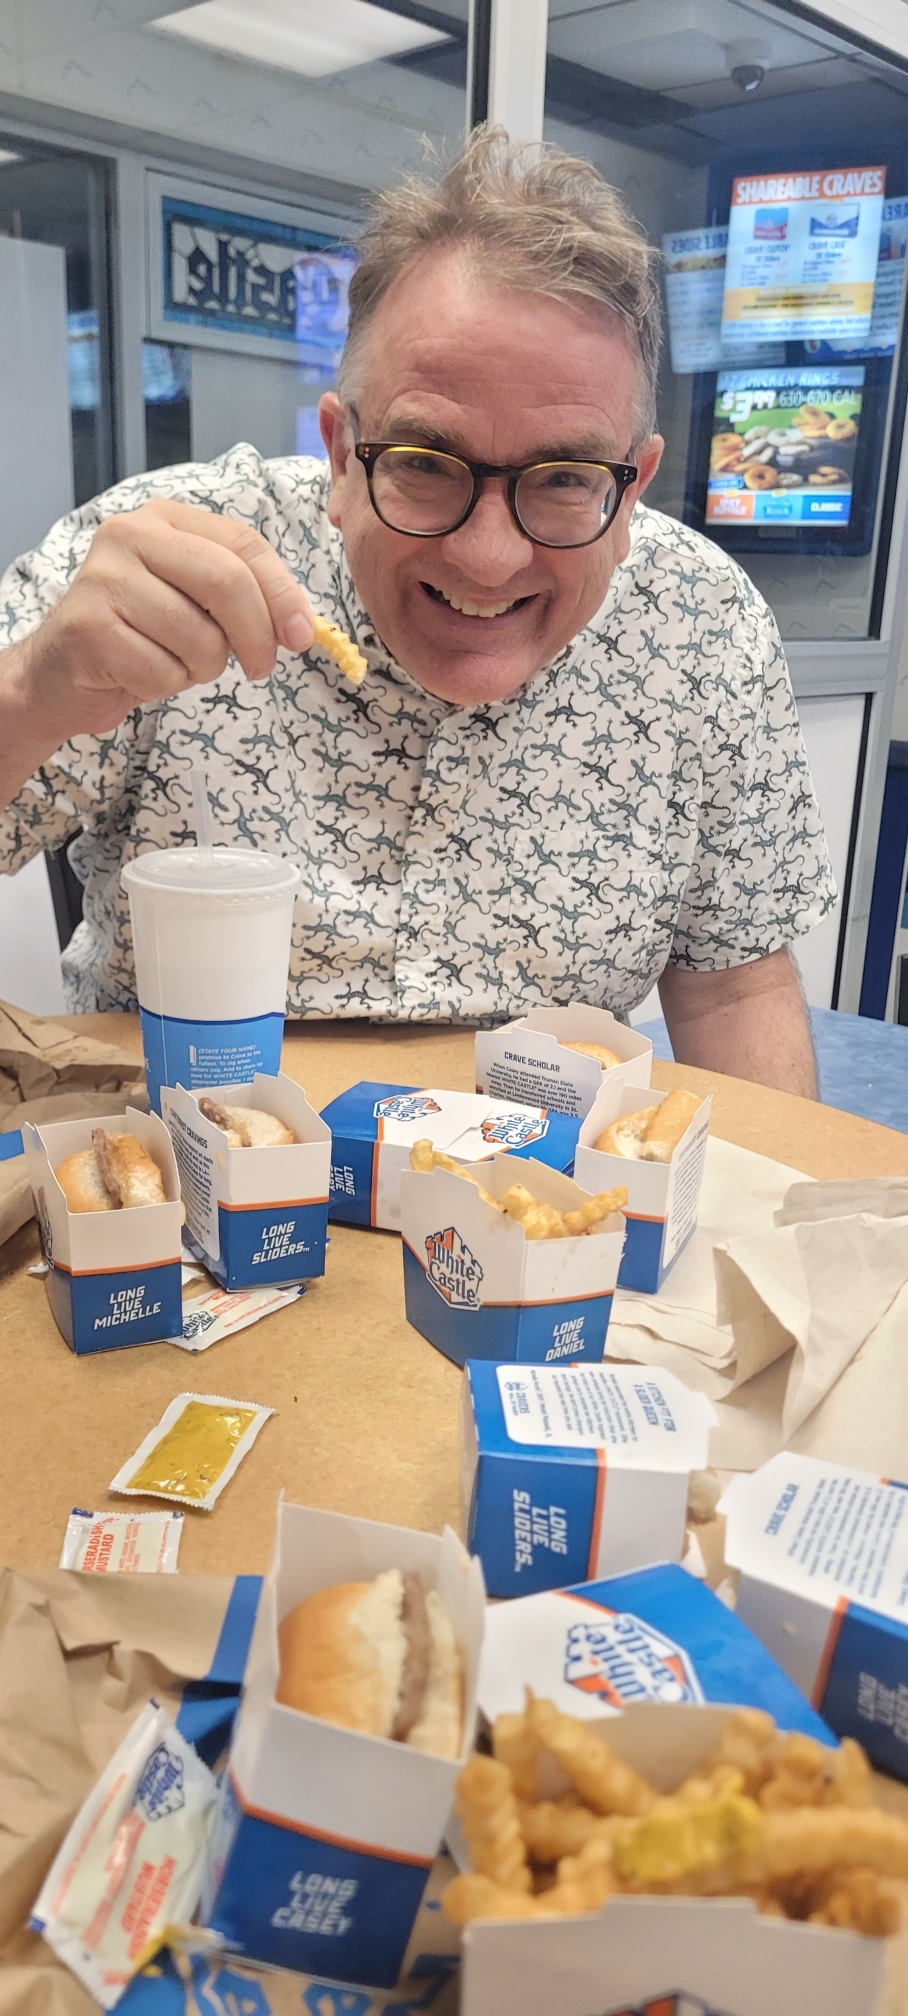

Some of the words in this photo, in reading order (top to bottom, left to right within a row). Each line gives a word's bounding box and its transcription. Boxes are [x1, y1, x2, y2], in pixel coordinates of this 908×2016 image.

[736, 176, 820, 204] SHAREABLE
[823, 171, 883, 196] CRAVES
[740, 373, 797, 387] CHICKEN
[798, 371, 840, 386] RINGS
[833, 389, 857, 406] CAL
[491, 1067, 512, 1078] University,
[493, 1062, 505, 1070] When
[520, 1070, 540, 1079] attended
[541, 1076, 559, 1084] Truman
[504, 1051, 526, 1064] CRAVE
[528, 1059, 560, 1072] SCHOLAR
[486, 1072, 501, 1080] nearest
[502, 1076, 516, 1085] WHITE
[489, 1085, 506, 1093] enrolled
[513, 1092, 539, 1103] Lindenwood
[540, 1100, 564, 1110] University
[521, 1089, 545, 1099] transferred
[547, 1095, 565, 1103] schools
[489, 1116, 528, 1143] White
[505, 1118, 545, 1145] Castle
[334, 1166, 345, 1191] LIVE
[344, 1166, 355, 1195] LONG
[261, 1221, 296, 1240] LONG
[263, 1234, 291, 1250] LIVE
[432, 1240, 476, 1281] White
[429, 1262, 477, 1304] Castle
[110, 1286, 146, 1304] LONG
[112, 1298, 143, 1315] LIVE
[94, 1302, 162, 1330] MICHELLE
[553, 1317, 585, 1337] LONG
[545, 1338, 585, 1362] DANIEL
[554, 1329, 581, 1348] LIVE
[531, 1506, 549, 1548] LIVE
[549, 1505, 568, 1555] LONG
[289, 1870, 359, 1899] LONG
[290, 1891, 350, 1914] LIVE
[270, 1907, 353, 1937] CASEY
